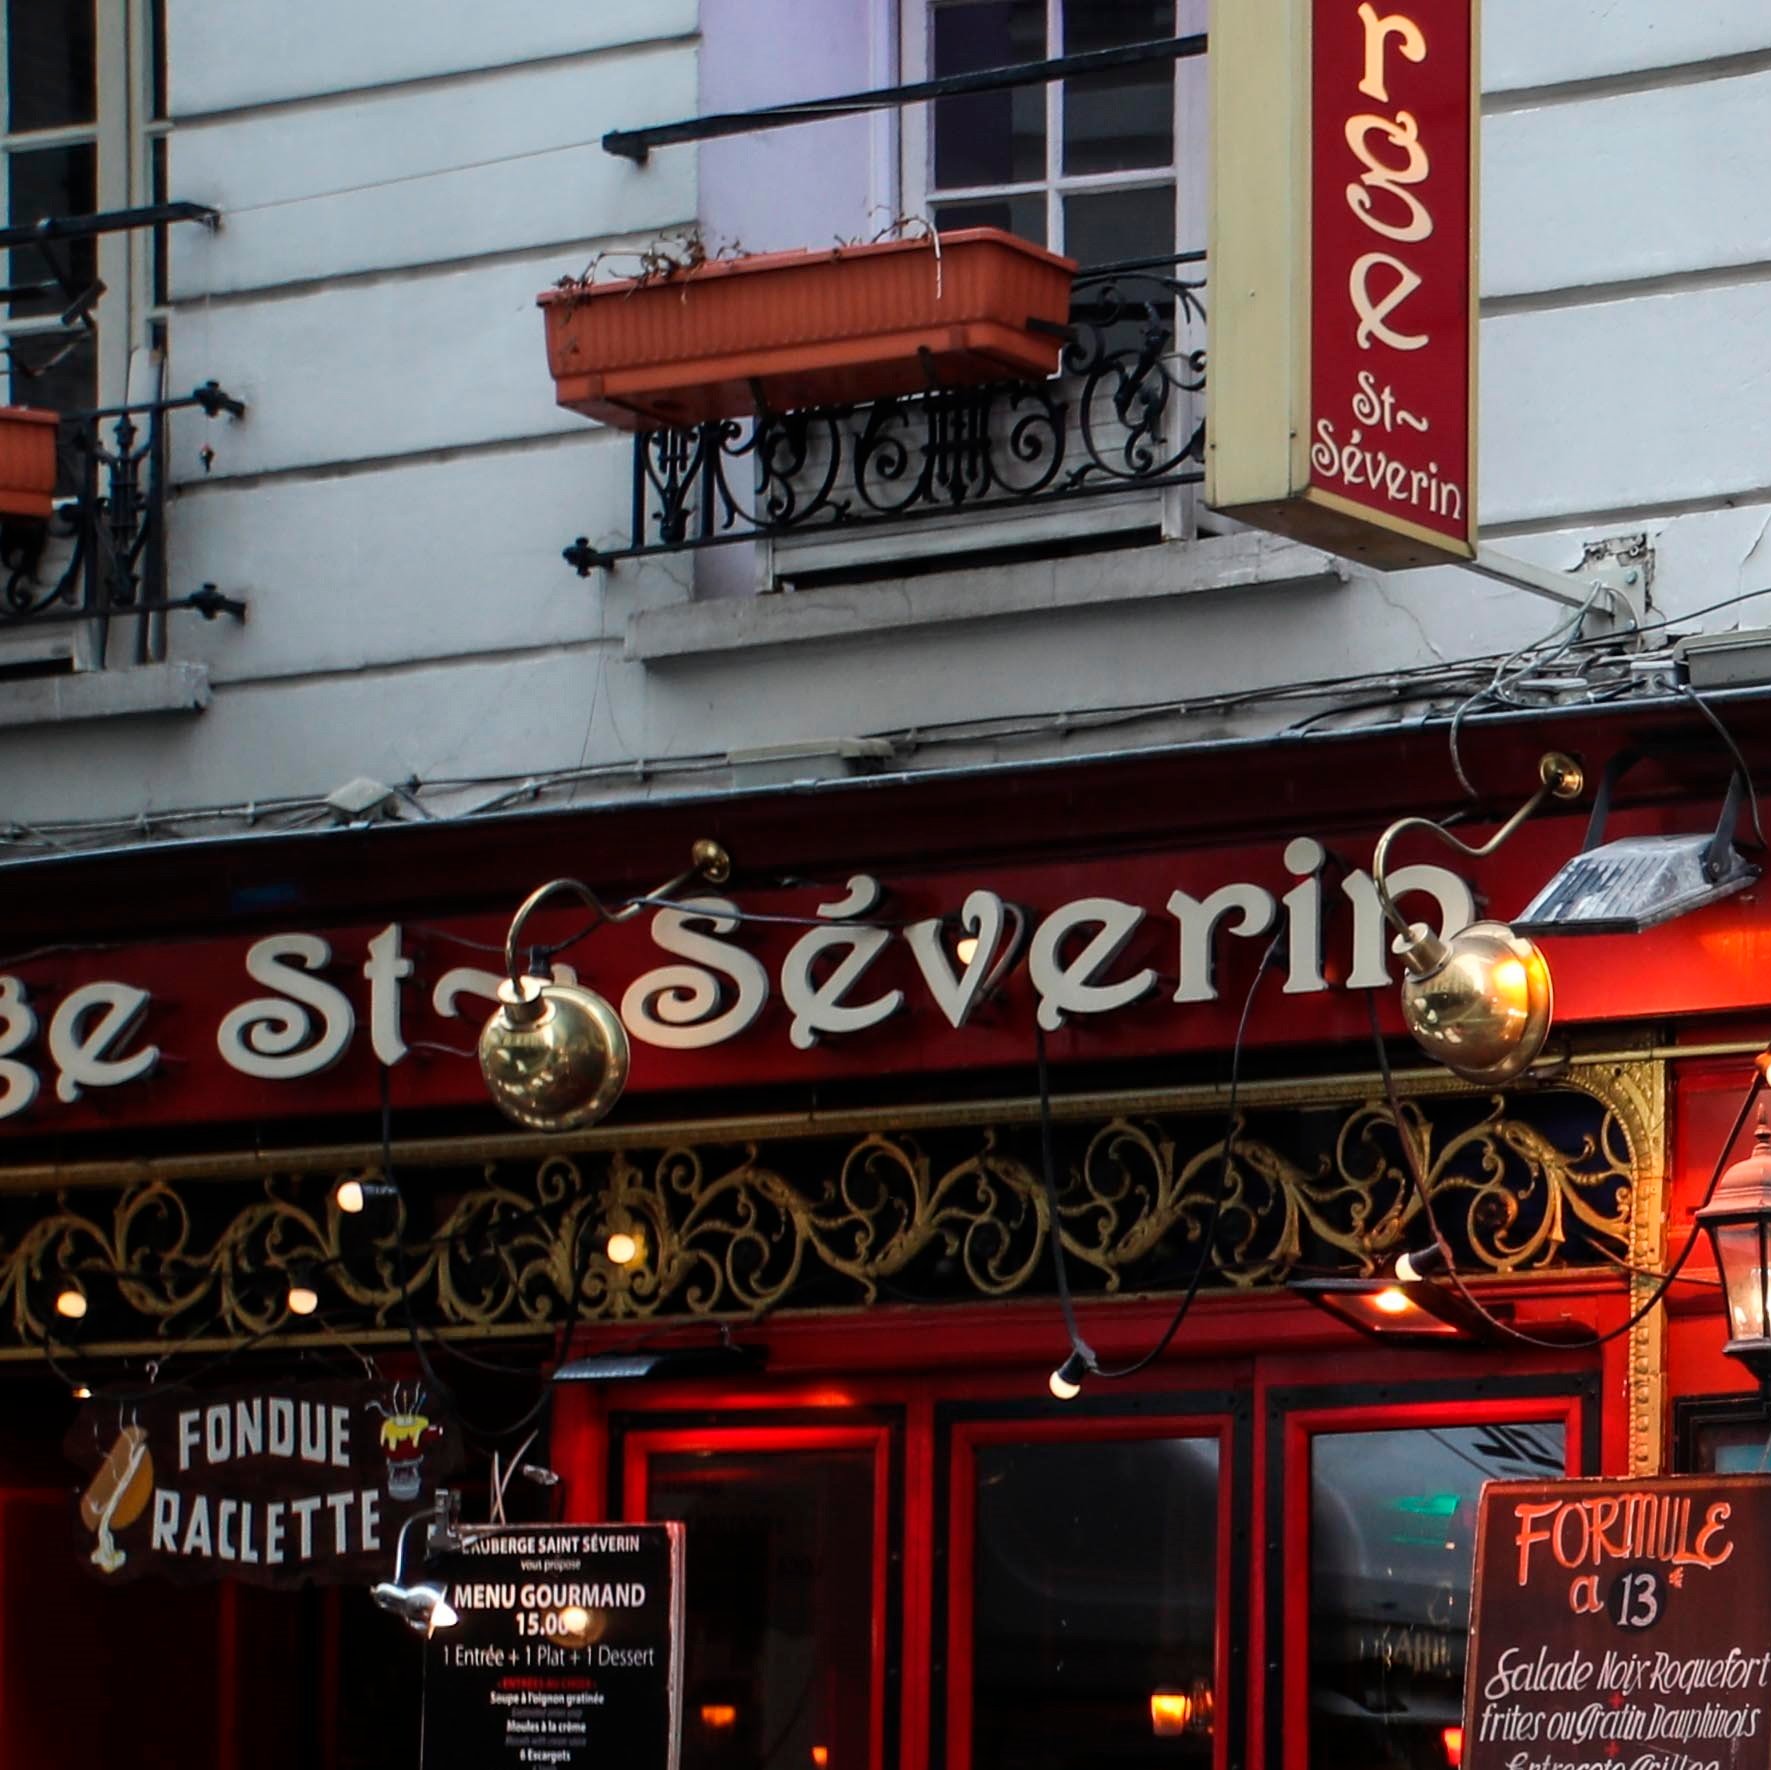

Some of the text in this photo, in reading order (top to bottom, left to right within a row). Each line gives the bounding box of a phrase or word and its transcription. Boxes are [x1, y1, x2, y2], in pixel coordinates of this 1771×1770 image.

[1311, 418, 1462, 520] Séverin
[178, 1397, 350, 1471] FONDUE
[151, 1487, 380, 1565] RACLETTE
[538, 1536, 580, 1554] SAINT
[583, 1533, 640, 1554] SÉVERIN
[454, 1583, 646, 1609] MENU GOURMAND
[1615, 1573, 1659, 1627] 13
[443, 1646, 449, 1666] 1
[455, 1644, 505, 1667] Entrée
[537, 1645, 565, 1667] Plat
[599, 1645, 655, 1668] Dessert
[1485, 1646, 1771, 1701] Salade Noix Roquefort
[1478, 1702, 1546, 1742] frites
[1648, 1702, 1761, 1742] Dauphinois
